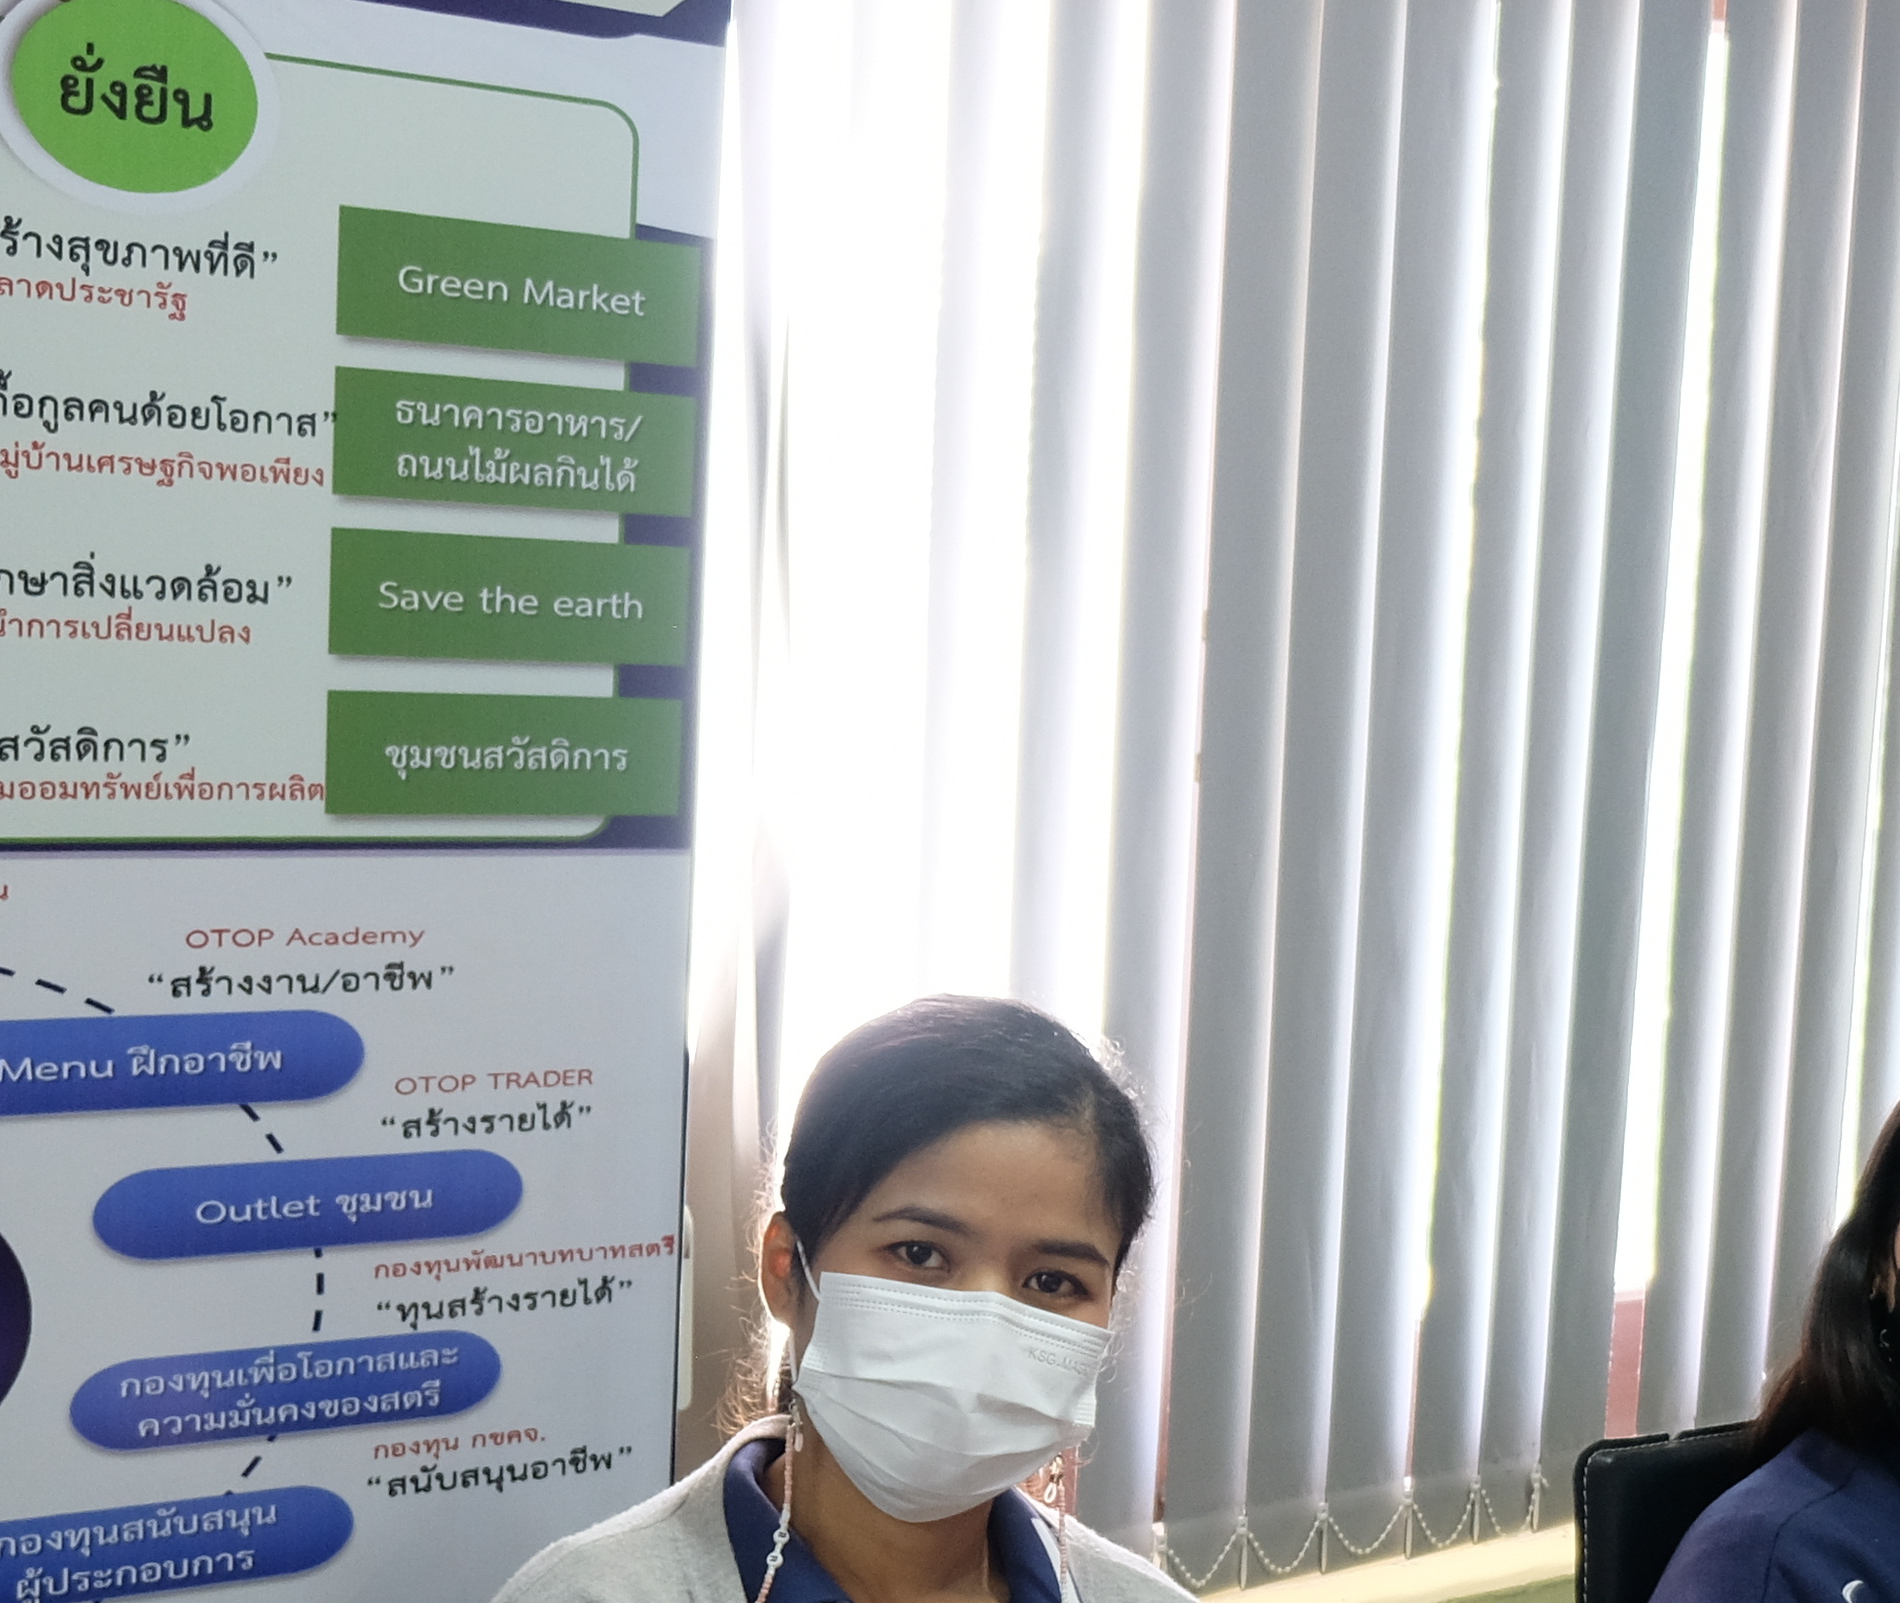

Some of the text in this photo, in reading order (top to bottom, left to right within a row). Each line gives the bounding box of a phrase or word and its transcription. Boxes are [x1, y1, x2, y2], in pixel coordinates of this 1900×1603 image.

[59, 43, 214, 134] ยั่งยืน
[397, 264, 646, 320] Green Market
[395, 397, 643, 447] ธนาคารอาหาร/
[395, 446, 638, 496] ถนนไม้ผลกินได้
[378, 578, 643, 623] Save the earth
[385, 733, 628, 782] ชุมชนสวัสดิการ
[184, 926, 426, 950] OTOP Academy
[127, 1041, 283, 1079] ฝึกอาชีพ
[395, 1068, 594, 1095] OTOP TRADER
[194, 1184, 435, 1226] Outlet ชุมชน
[374, 1235, 676, 1281] กองทุนพัฒนาบทบาทสตรี
[119, 1342, 461, 1402] กองทุนเพื่อโอกาสและ
[136, 1377, 443, 1441] ความมั่นคงของสตรี
[373, 1427, 546, 1460] กองทุน กขคจ.
